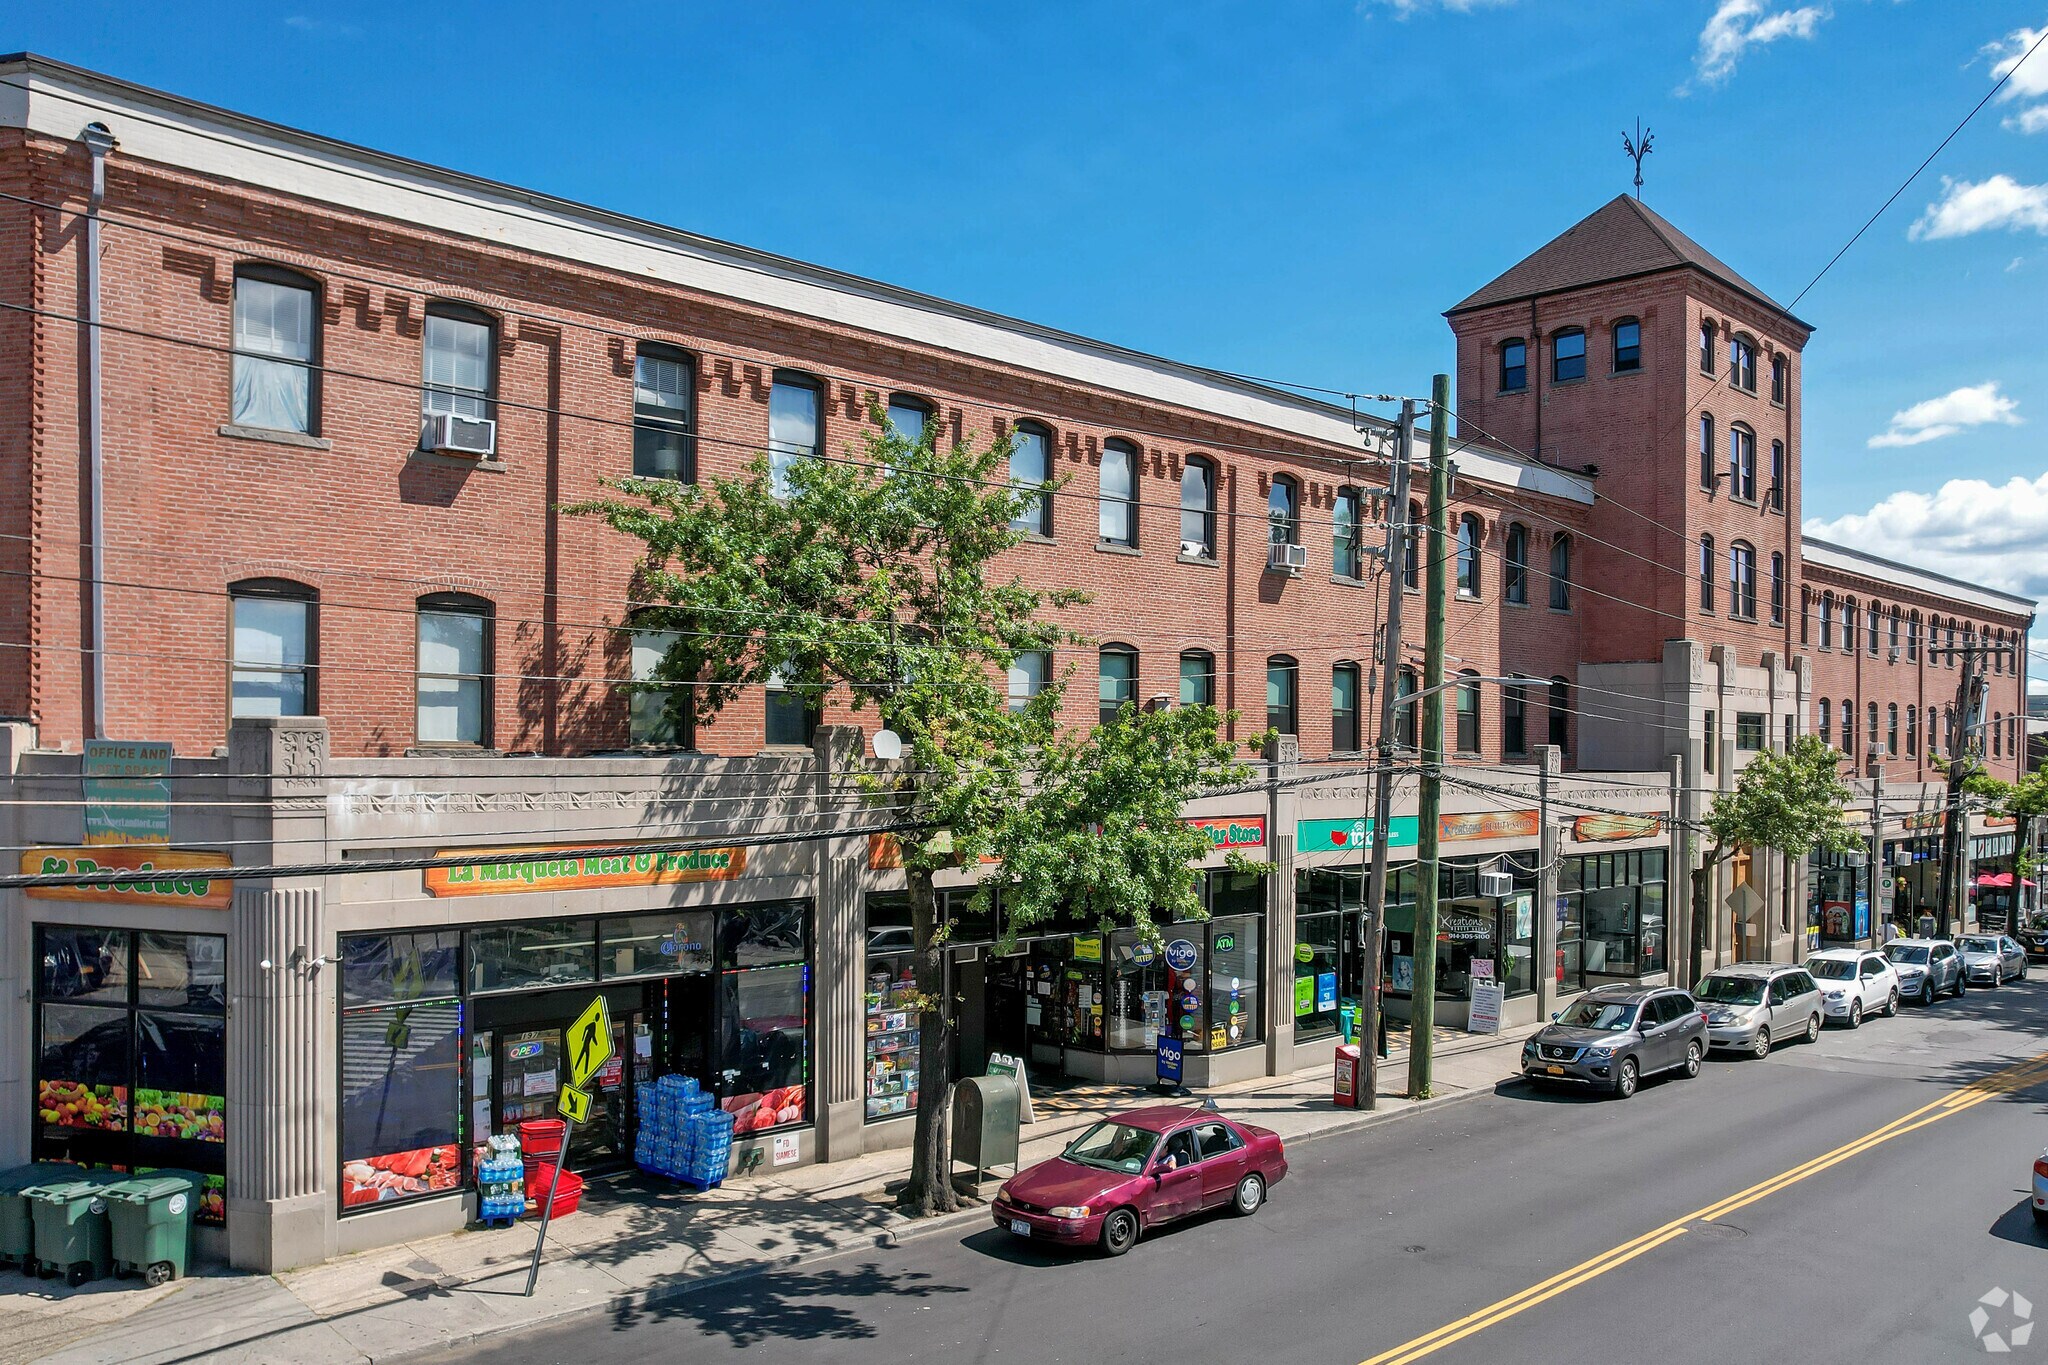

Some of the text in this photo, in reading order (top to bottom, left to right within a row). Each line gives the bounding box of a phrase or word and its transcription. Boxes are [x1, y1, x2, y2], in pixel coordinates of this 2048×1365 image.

[89, 747, 168, 760] OFFICE AND
[87, 763, 166, 776] LOFT SPACE
[1484, 821, 1511, 832] BEAUTY
[1511, 818, 1534, 830] SALON
[1228, 823, 1261, 844] Store
[448, 850, 730, 884] La Marqueta Meat & Produce
[74, 857, 210, 897] Produce
[1437, 913, 1484, 929] Kreations
[1216, 938, 1234, 950] ATM
[1169, 946, 1194, 959] vigo
[521, 1032, 539, 1041] 197
[1211, 1031, 1226, 1041] ATM
[510, 1042, 541, 1058] OPEN
[1159, 1046, 1181, 1061] vigo
[782, 1139, 790, 1148] FD
[775, 1148, 798, 1161] SIAMESE
